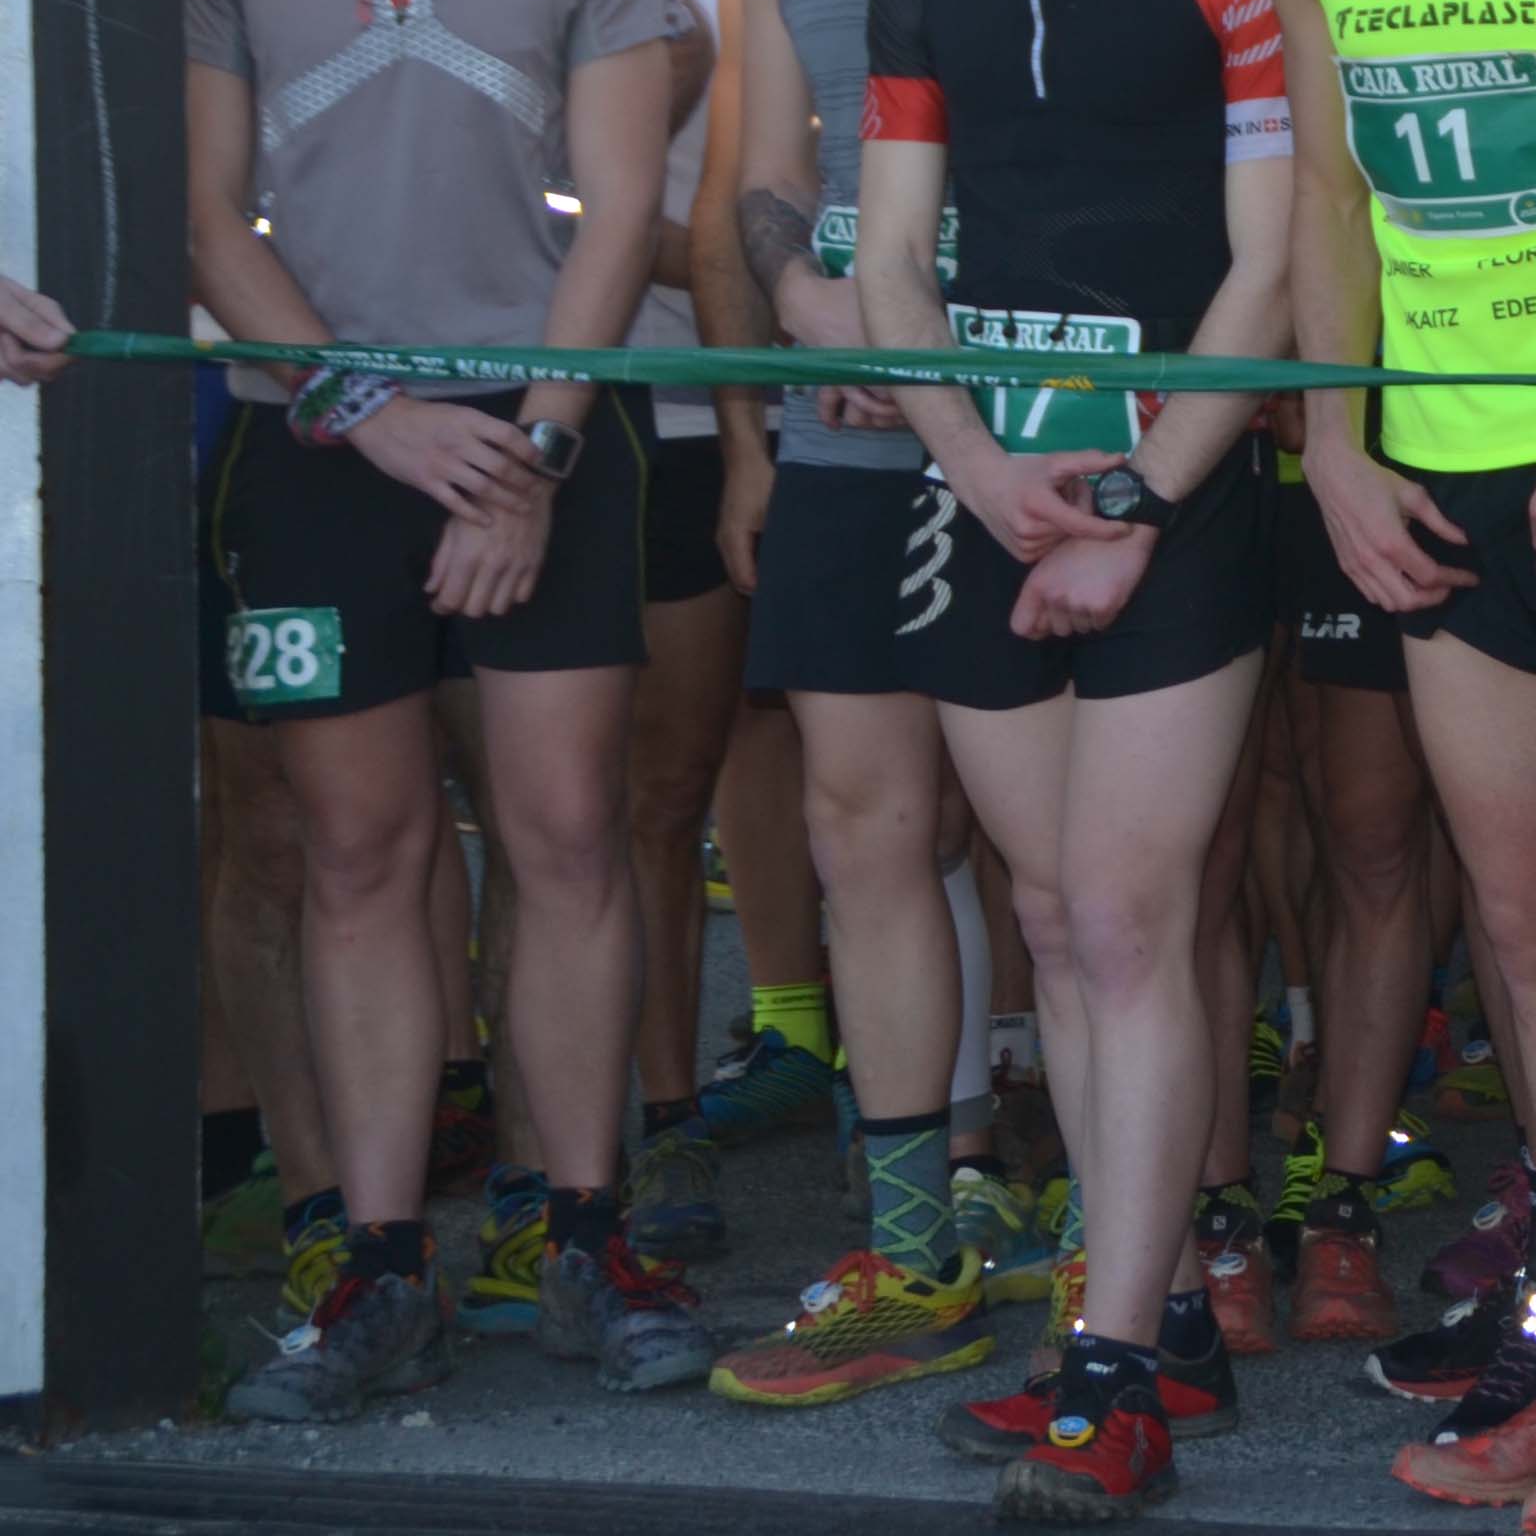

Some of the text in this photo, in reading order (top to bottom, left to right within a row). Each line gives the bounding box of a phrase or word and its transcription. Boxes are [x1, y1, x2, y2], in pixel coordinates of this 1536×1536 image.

[1351, 58, 1529, 97] CAJA RURAL
[1394, 108, 1477, 184] 11
[965, 317, 1115, 353] CJA RURAL
[1406, 308, 1460, 331] KAITZ
